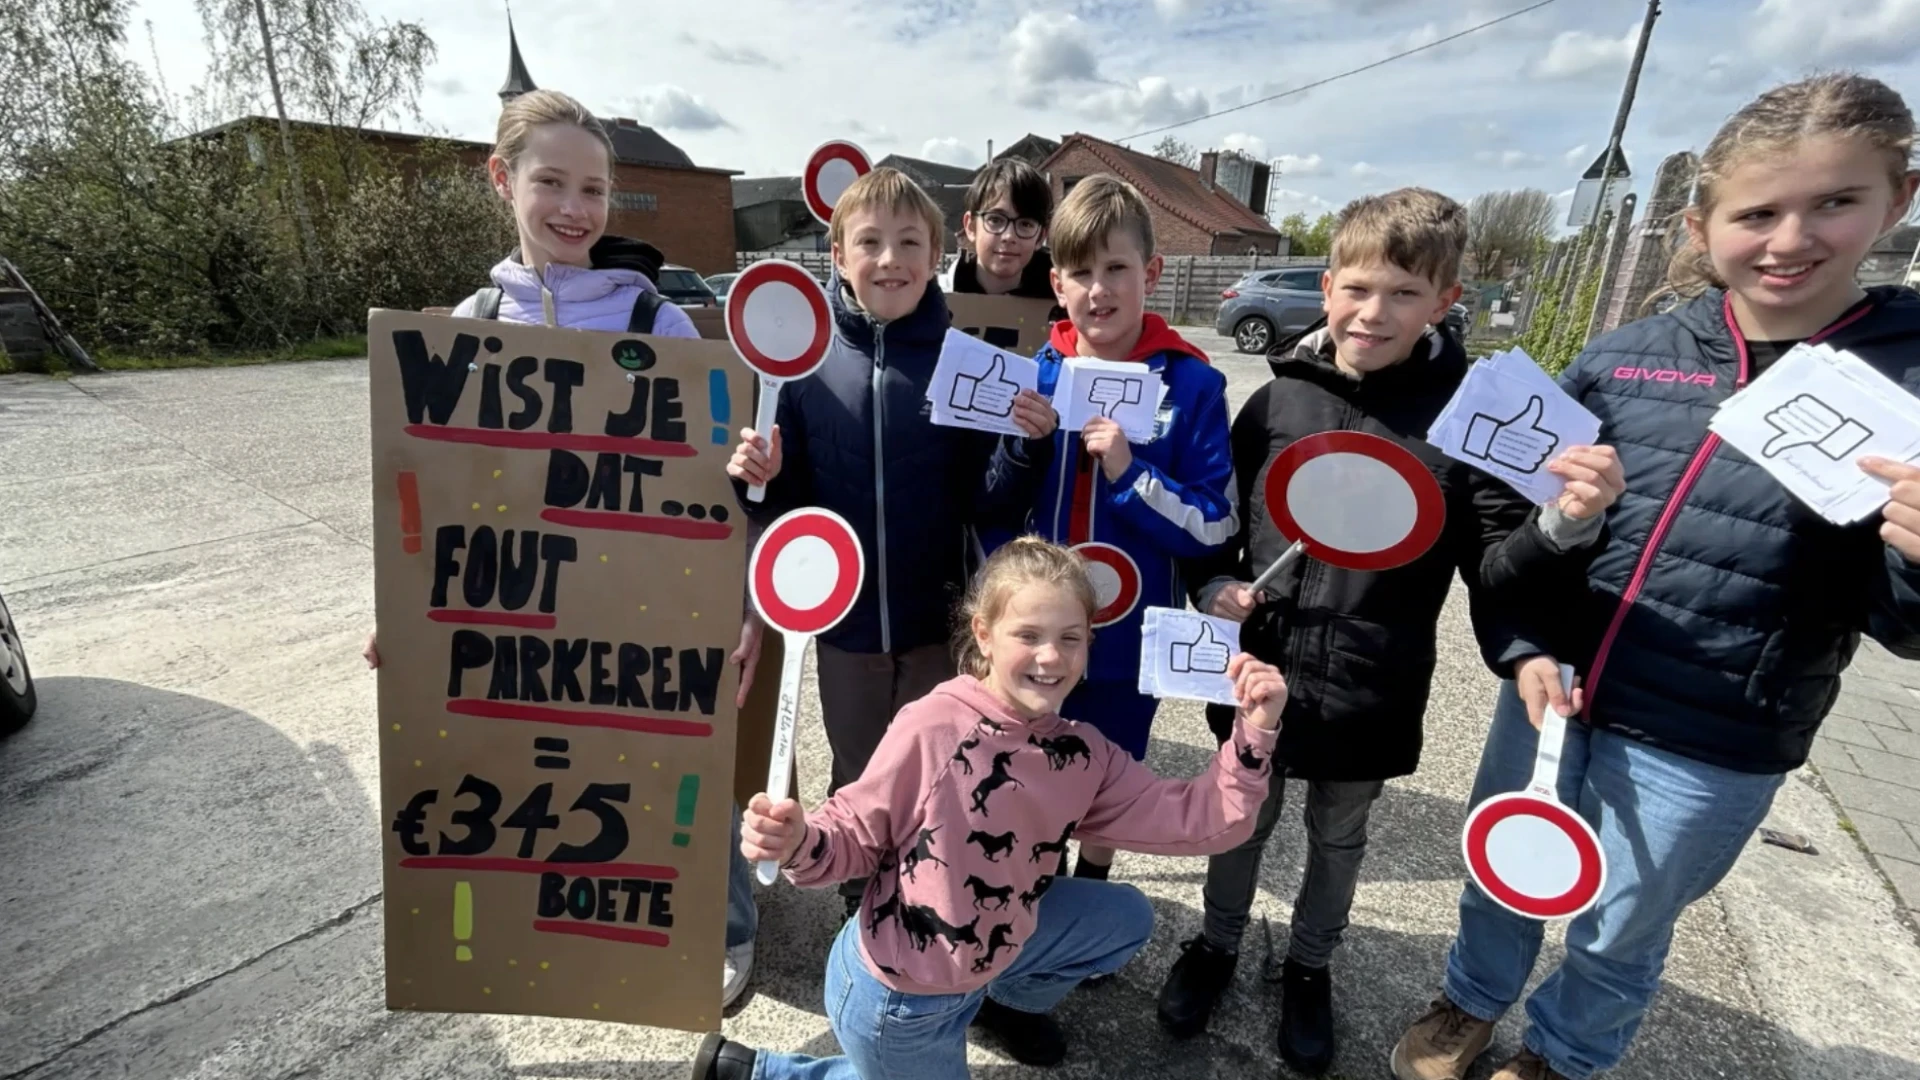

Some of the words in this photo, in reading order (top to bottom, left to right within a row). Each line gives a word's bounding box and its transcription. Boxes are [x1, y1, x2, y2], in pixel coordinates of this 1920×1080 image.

[1613, 366, 1716, 387] GIVOVA
[430, 525, 577, 613] FOUT
[448, 629, 725, 715] PARKEREN
[392, 774, 631, 862] €345
[537, 872, 674, 928] BOETE
